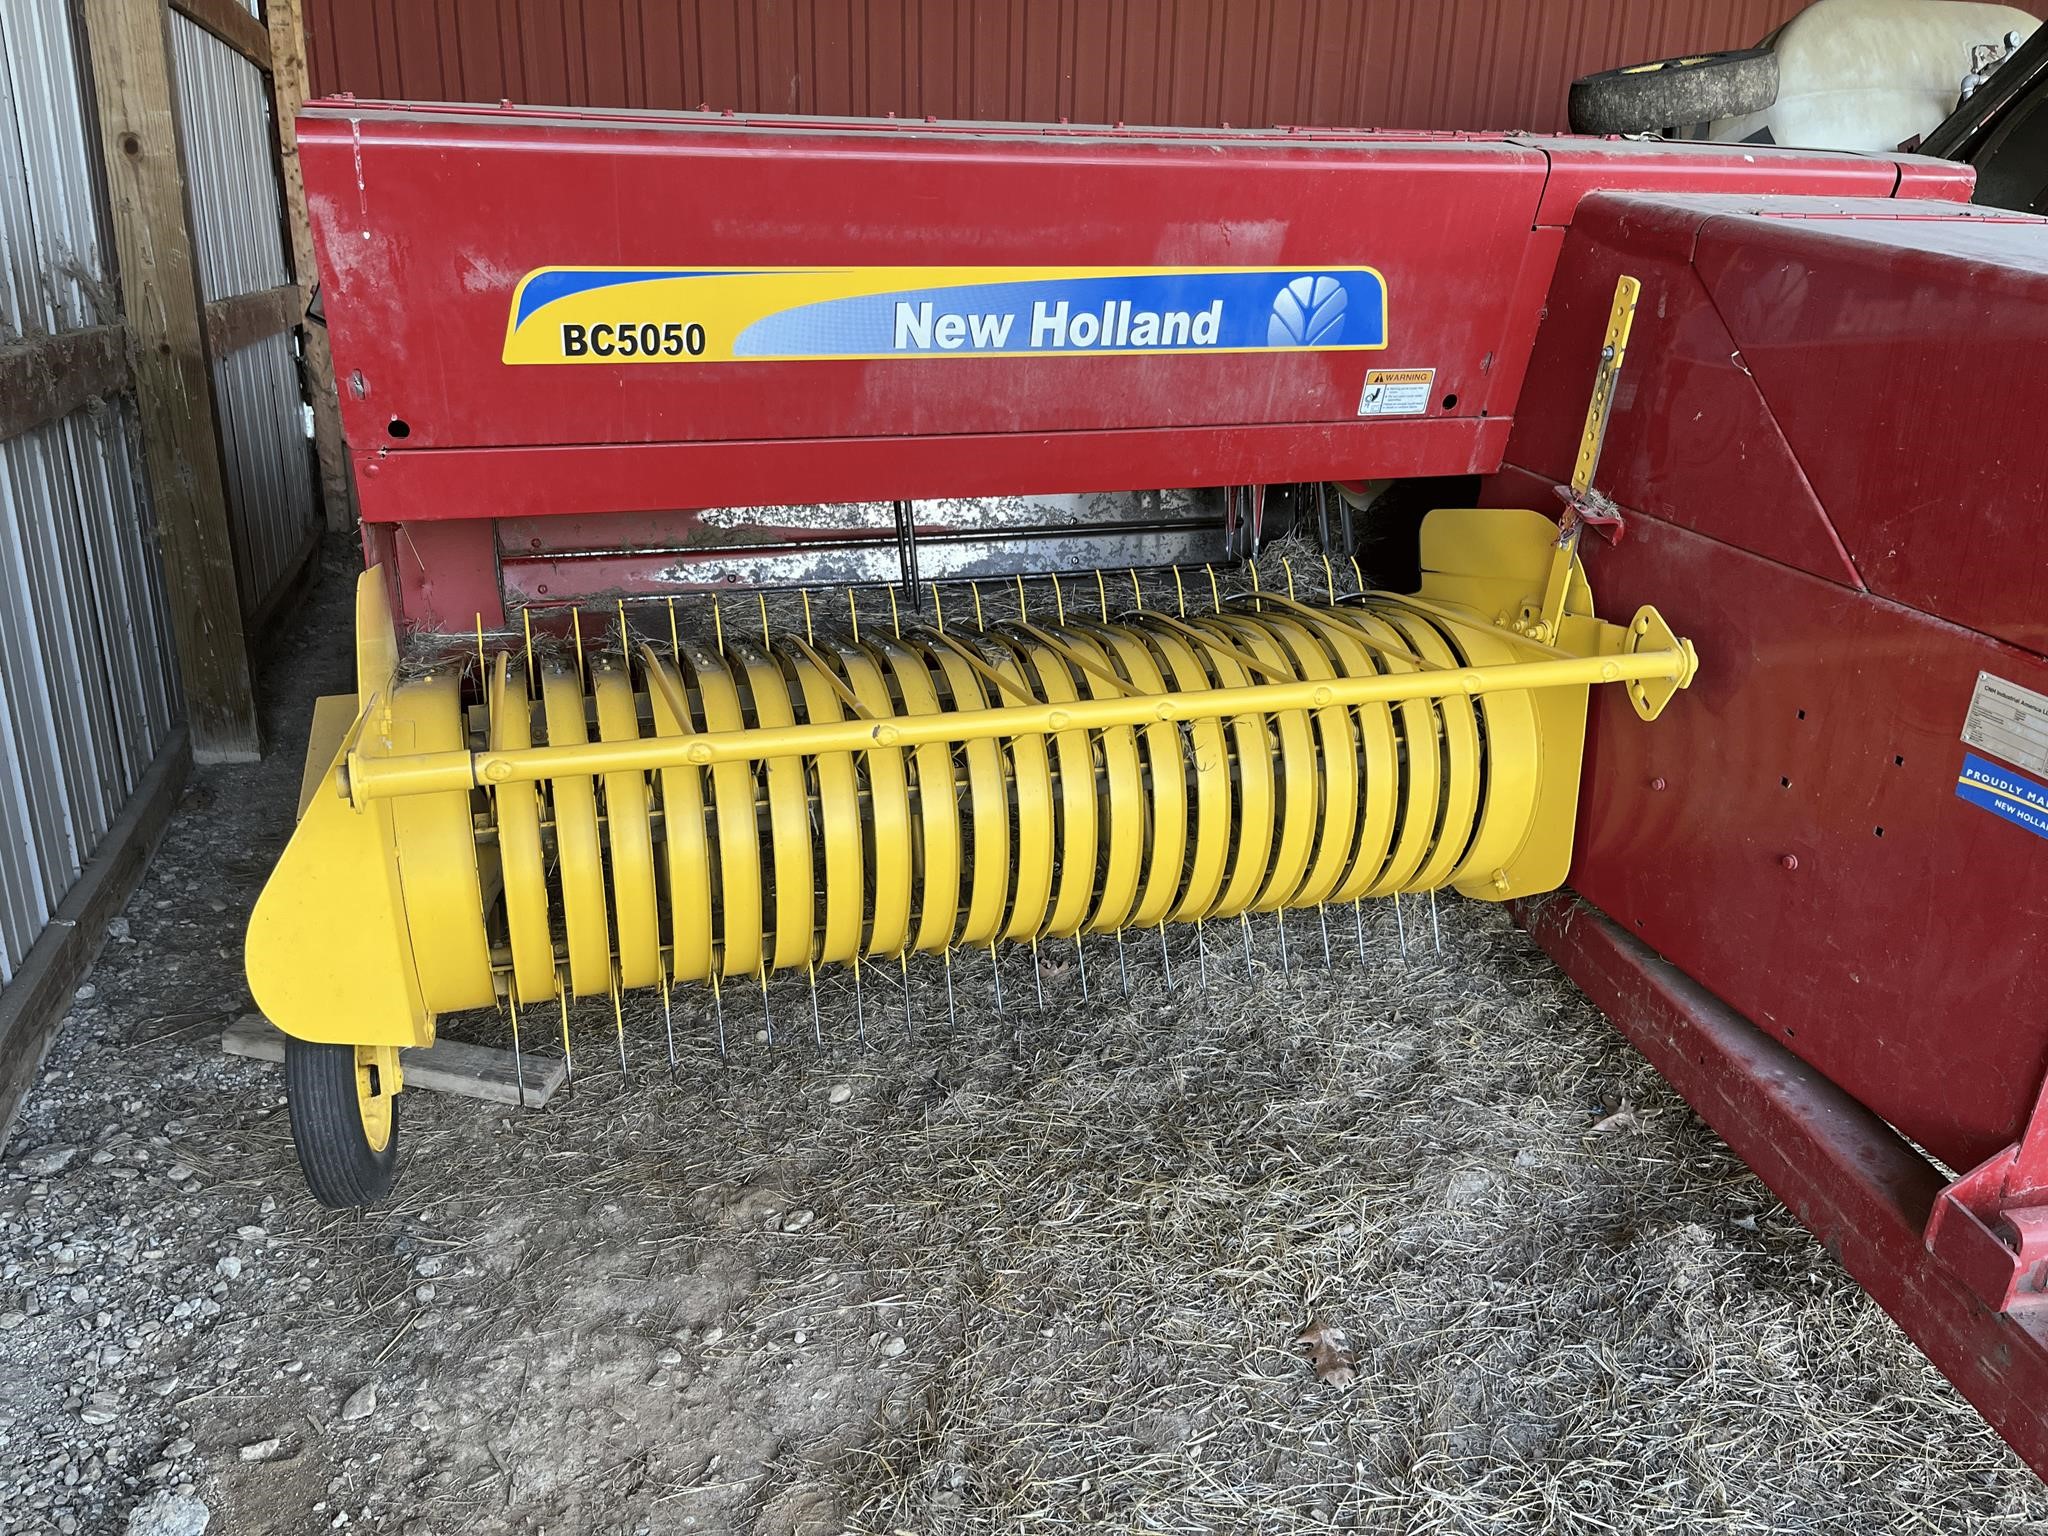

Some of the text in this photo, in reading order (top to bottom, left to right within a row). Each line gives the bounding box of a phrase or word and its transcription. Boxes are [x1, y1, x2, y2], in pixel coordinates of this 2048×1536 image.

[562, 323, 706, 357] BC5050
[893, 300, 1224, 349] New Holland
[1385, 373, 1427, 381] WARNING
[1966, 768, 2048, 808] PROUDLY MA
[1994, 799, 2048, 831] NEW HOLLA
